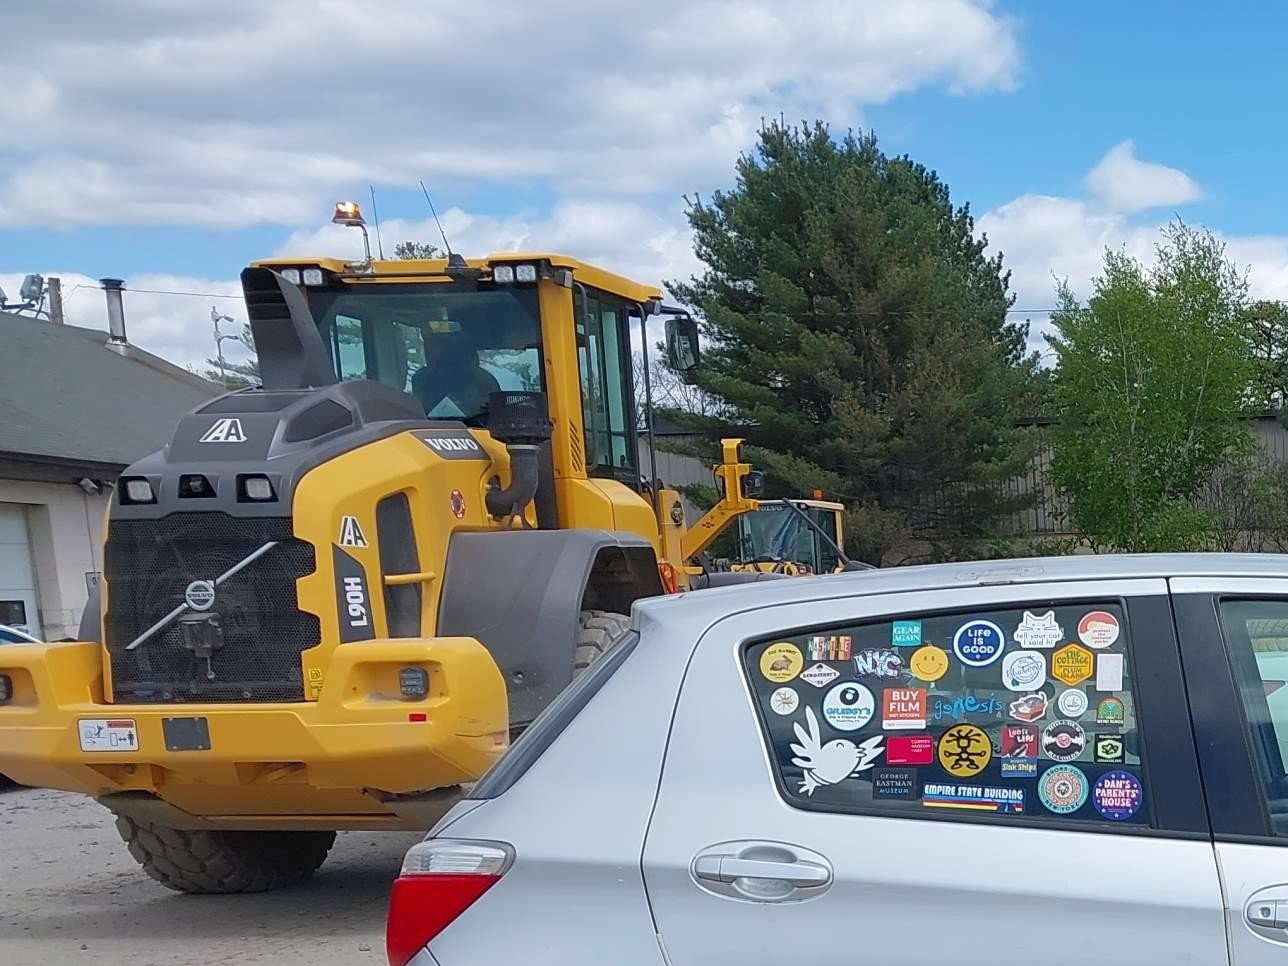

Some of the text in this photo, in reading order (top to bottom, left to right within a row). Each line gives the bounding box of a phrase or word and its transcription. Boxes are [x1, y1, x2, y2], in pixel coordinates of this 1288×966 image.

[424, 438, 478, 450] VOLVO
[894, 626, 920, 634] GEAR
[808, 639, 850, 653] NASHVILLE
[963, 646, 994, 654] GOOD
[854, 650, 902, 677] NYC
[1057, 656, 1088, 664] COTTAGE
[892, 691, 919, 701] BUY
[890, 702, 920, 712] FILM
[1104, 779, 1130, 788] DAN'S
[924, 784, 1024, 800] EMPIRE STATE BUILDING
[1095, 788, 1139, 797] PARENTS'
[1101, 798, 1131, 807] HOUSE
